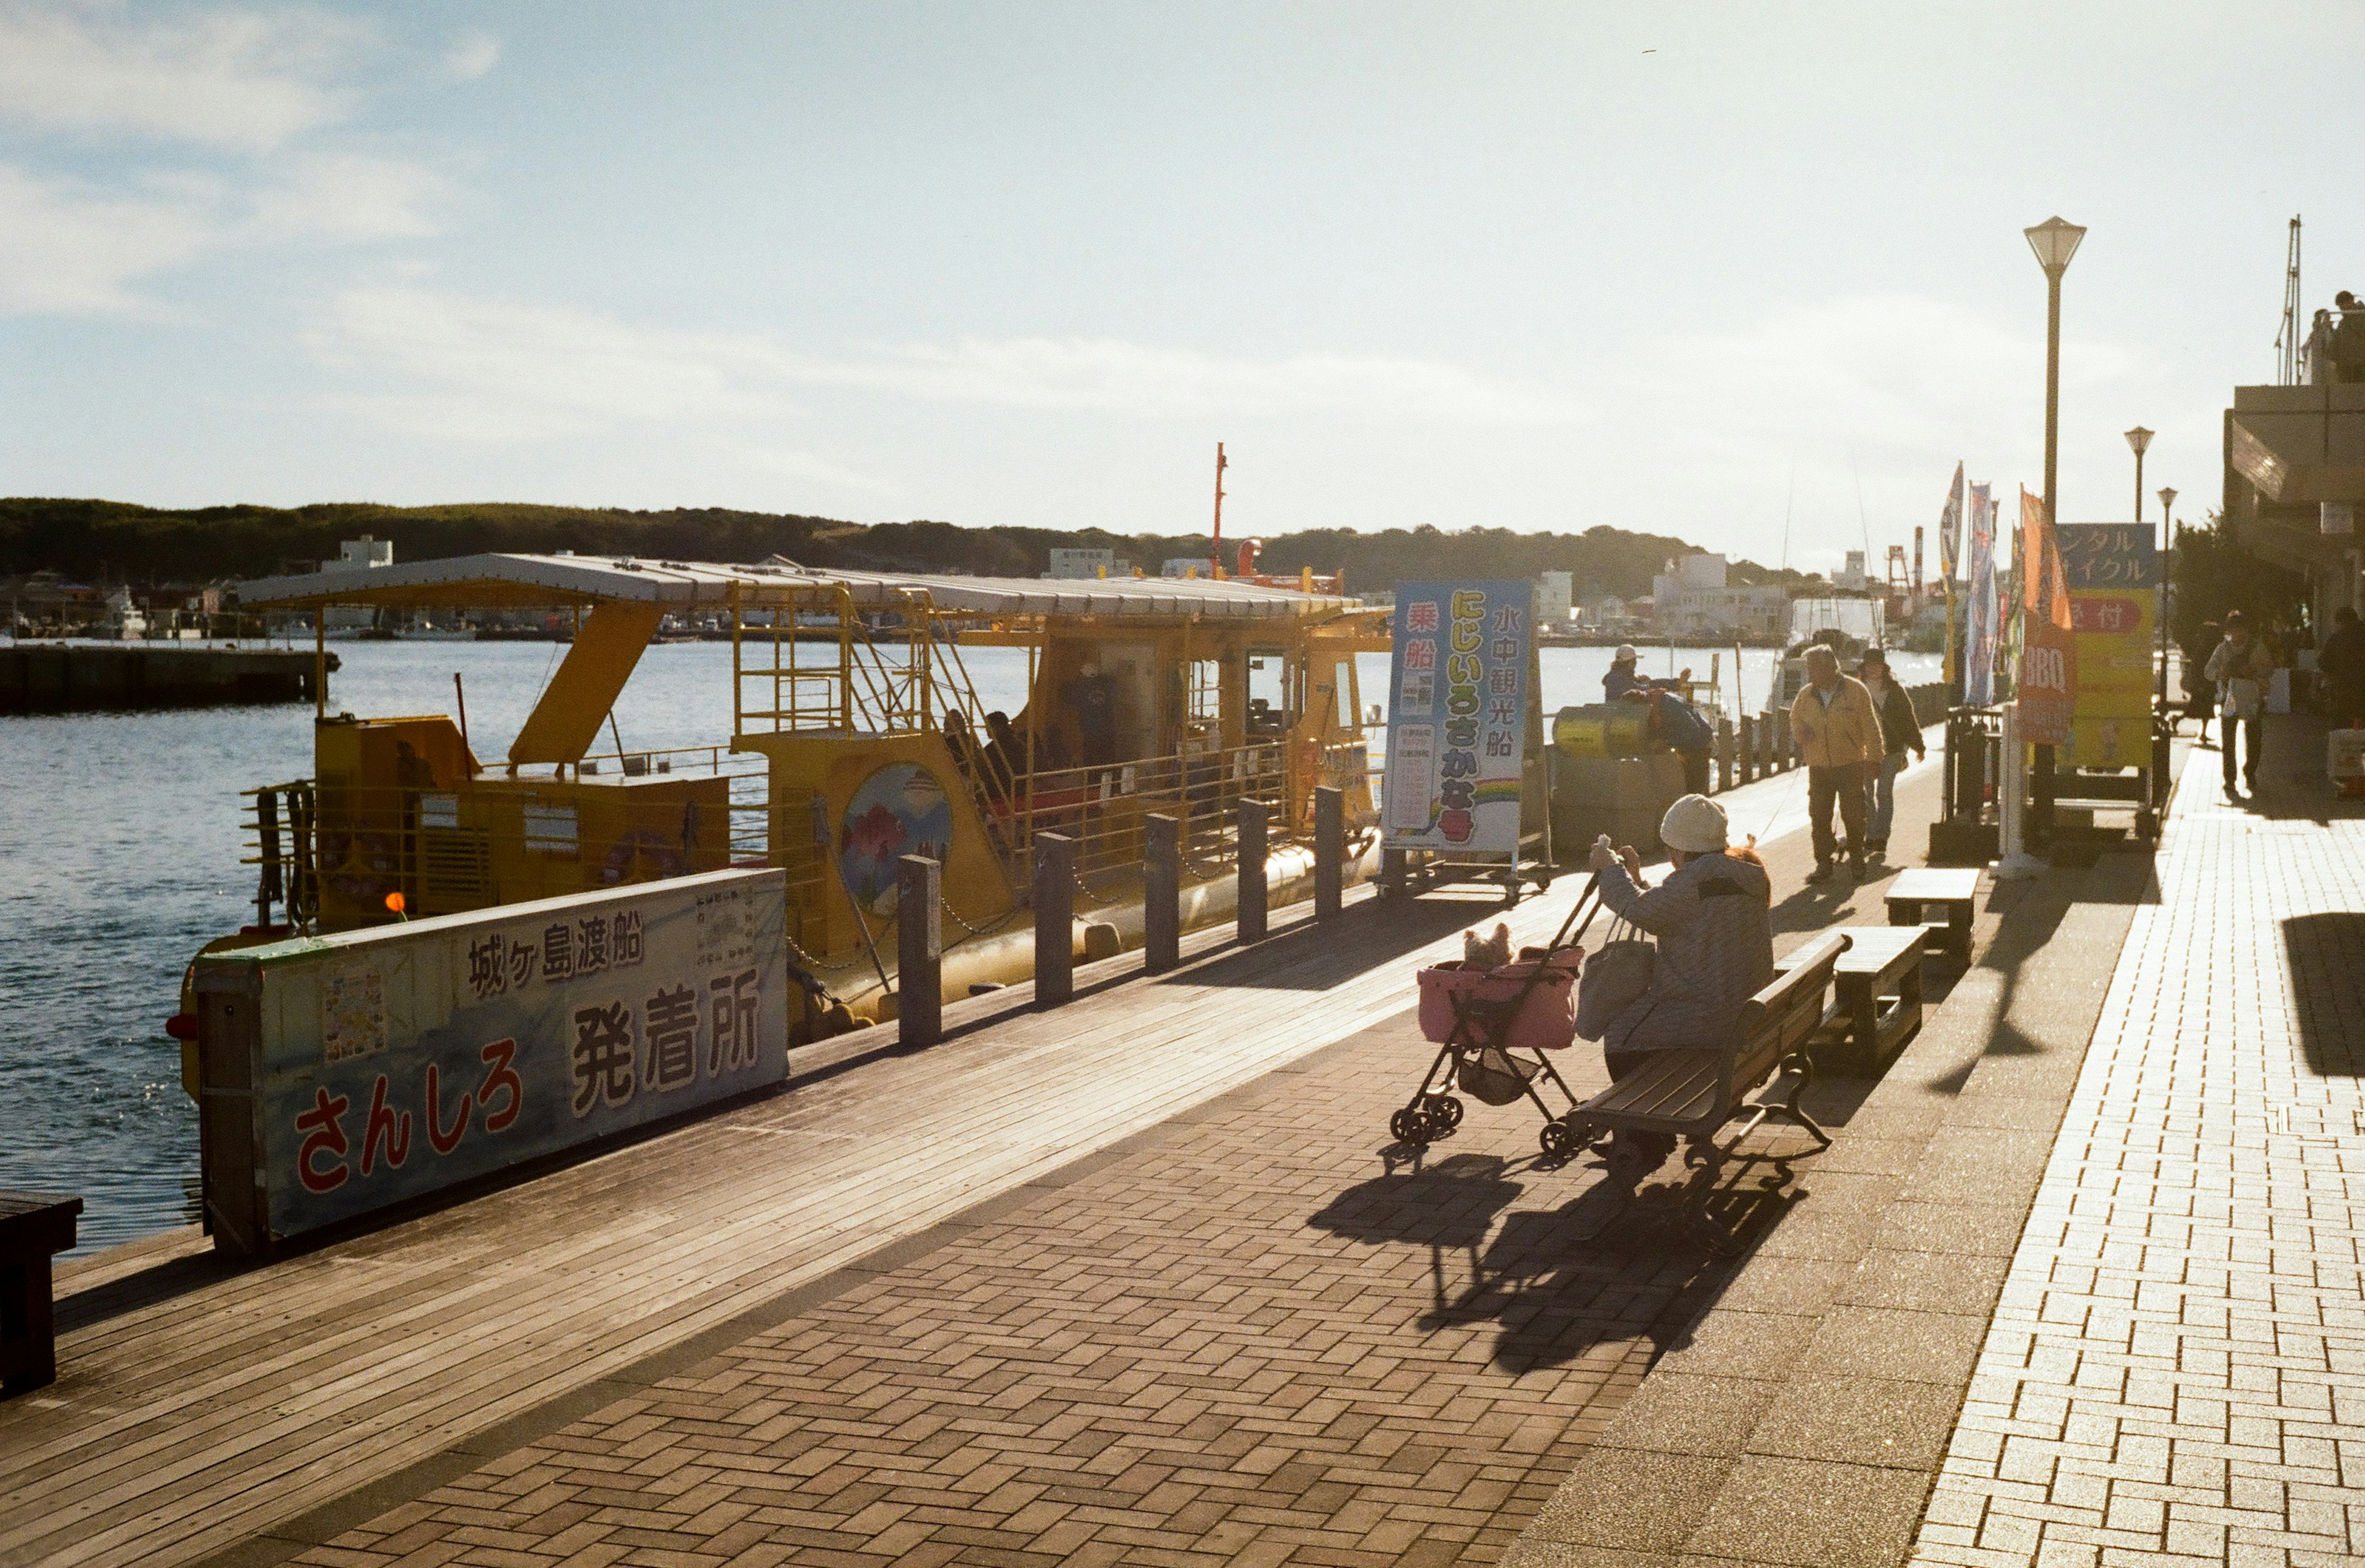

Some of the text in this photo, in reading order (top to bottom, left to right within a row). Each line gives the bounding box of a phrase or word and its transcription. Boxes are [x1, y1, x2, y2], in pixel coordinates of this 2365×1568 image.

[1404, 601, 1438, 669] 乗船
[1486, 605, 1521, 758] 水中観光船
[2026, 645, 2066, 693] BBQ
[295, 1037, 524, 1194] さんしろ
[570, 969, 761, 1120] 発着所
